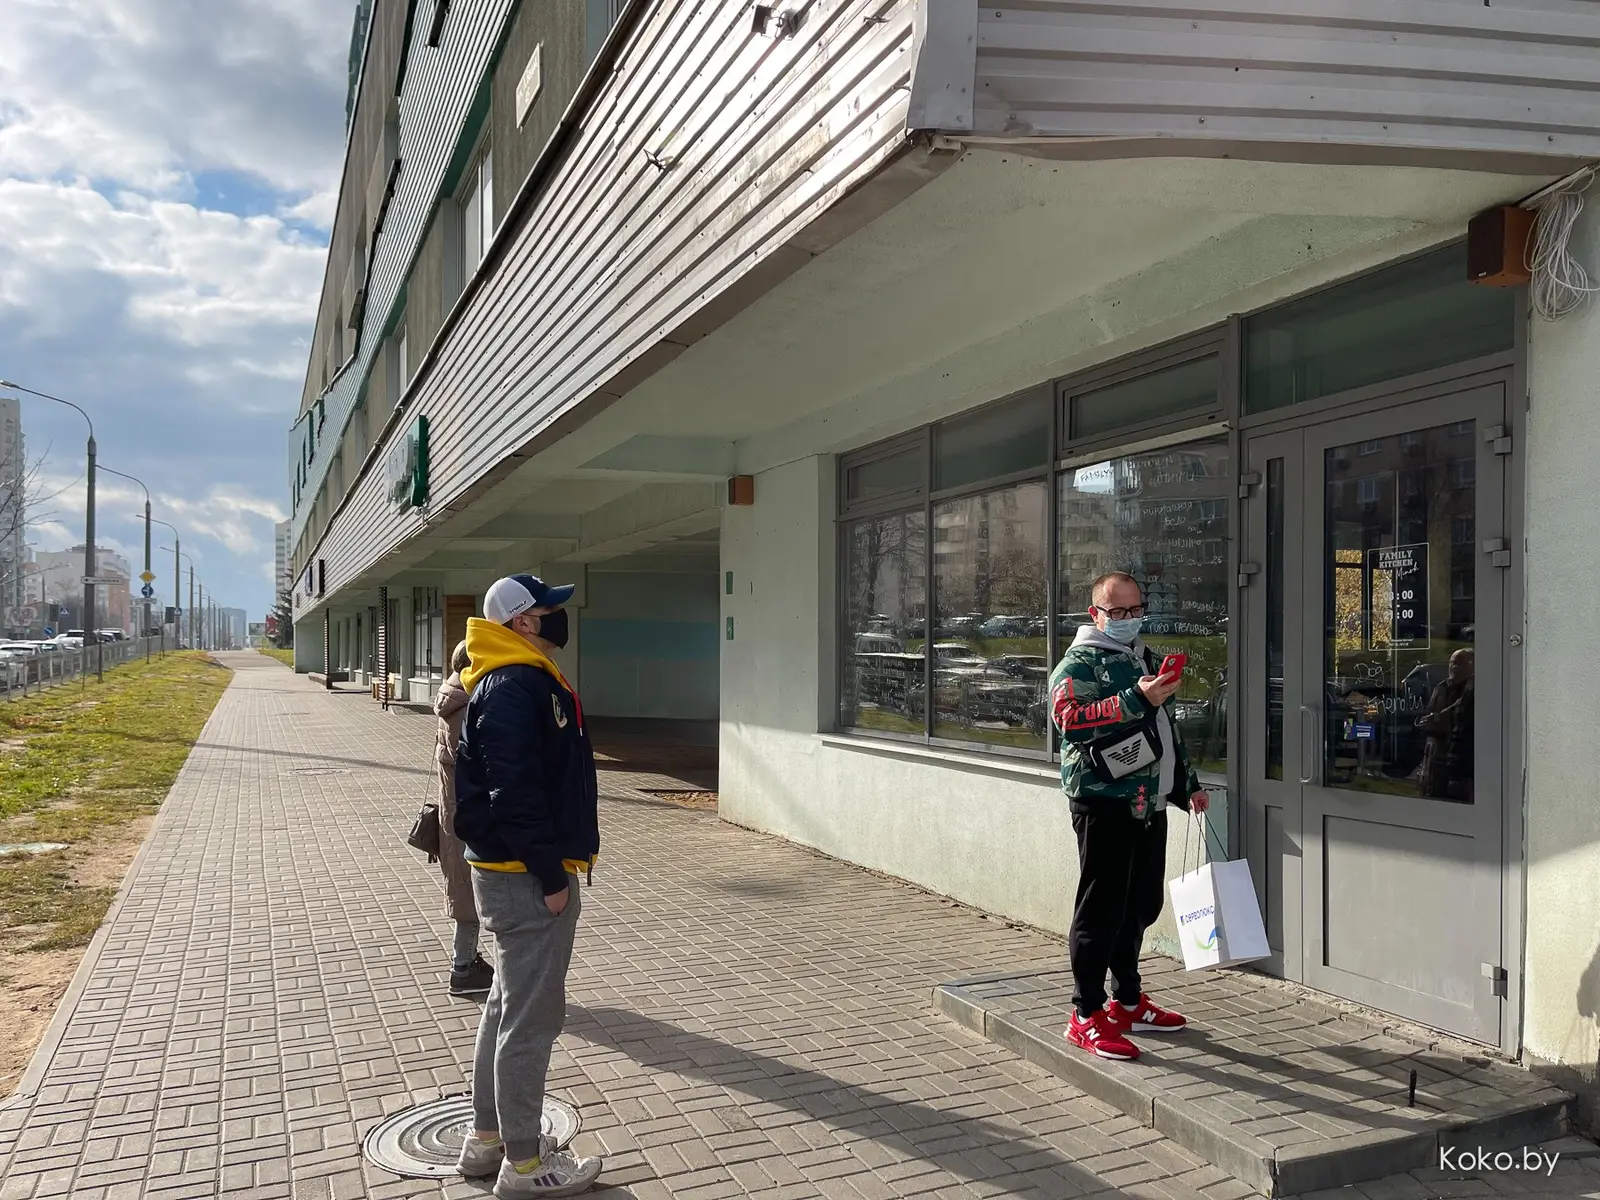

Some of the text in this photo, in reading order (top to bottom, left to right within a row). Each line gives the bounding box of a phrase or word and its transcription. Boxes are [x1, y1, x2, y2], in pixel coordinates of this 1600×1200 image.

[1379, 550, 1412, 561] FAMILY
[1379, 558, 1413, 569] KITCHEN
[1396, 561, 1419, 580] Minsk
[1353, 662, 1385, 688] Dog
[1142, 1010, 1157, 1022] N
[1086, 1027, 1100, 1041] N
